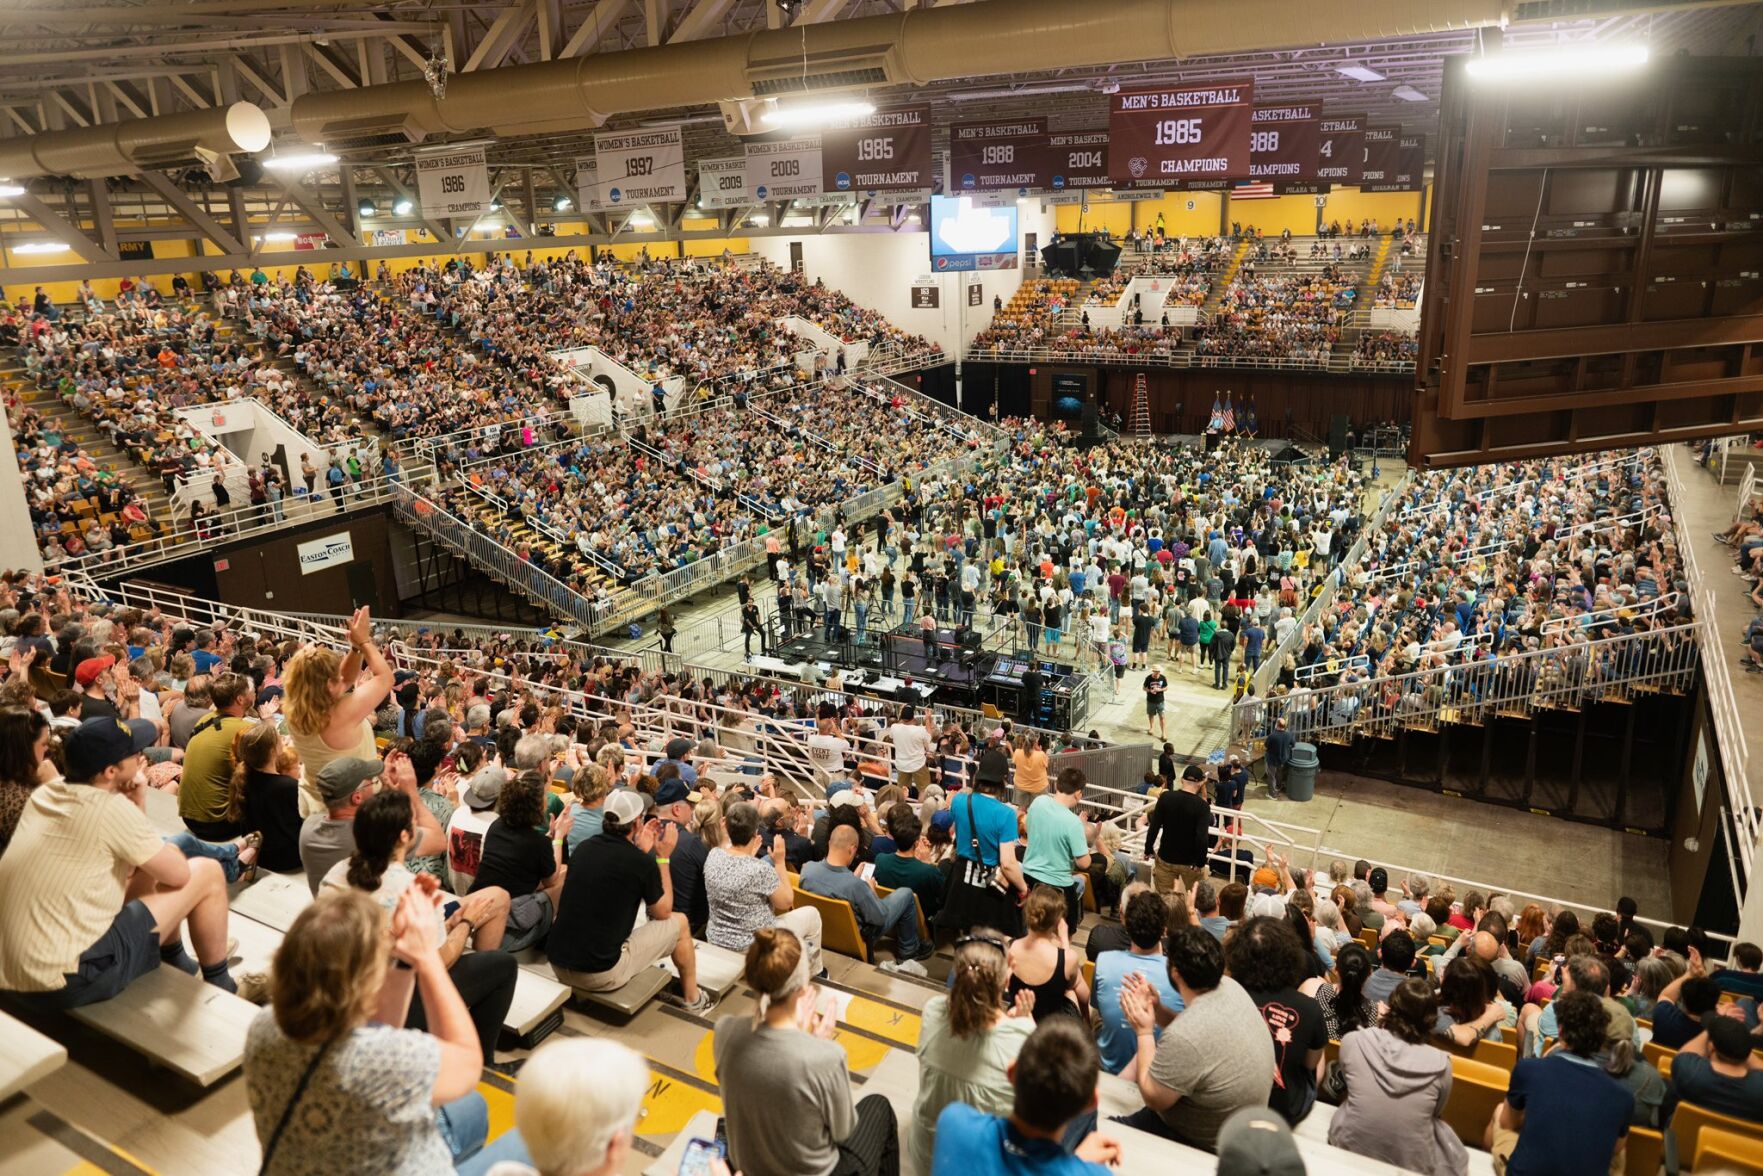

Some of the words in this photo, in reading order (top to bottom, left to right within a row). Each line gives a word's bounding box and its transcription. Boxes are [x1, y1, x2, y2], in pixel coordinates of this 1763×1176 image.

[1122, 94, 1158, 109] MEN'S
[1161, 89, 1240, 107] BASKETBALL
[861, 112, 920, 127] BASKETBALL
[958, 128, 984, 138] MEN'S
[985, 124, 1038, 136] BASKETBALL
[1155, 118, 1202, 145] 1985
[597, 138, 630, 151] WOMEN'S
[632, 132, 680, 147] BASKETBALL
[1050, 136, 1073, 146] MEN'S
[747, 144, 778, 154] WOMEN'S
[857, 138, 894, 160] 1985
[982, 146, 1014, 164] 1988
[418, 158, 444, 170] WOMEN'S
[446, 154, 484, 166] BASKETBALL
[625, 156, 653, 176] 1997
[1068, 152, 1102, 168] 2004
[1161, 158, 1228, 173] CHAMPIONS
[771, 160, 800, 177] 2009
[442, 174, 465, 194] 1986
[720, 176, 742, 190] 2009
[856, 172, 918, 186] TOURNAMENT
[980, 174, 1036, 186] TOURNAMENT
[1136, 178, 1180, 187] TOURNAMENT
[625, 186, 675, 199] TOURNAMENT
[771, 185, 817, 196] TOURNAMENT
[448, 202, 481, 212] CHAMPIONS
[1188, 201, 1194, 210] 9
[1316, 196, 1324, 206] 10
[1082, 204, 1088, 213] 8
[419, 228, 426, 237] 4
[949, 258, 972, 268] pepsi
[270, 444, 294, 496] 1
[300, 551, 326, 562] EASTON
[328, 544, 350, 555] COACH
